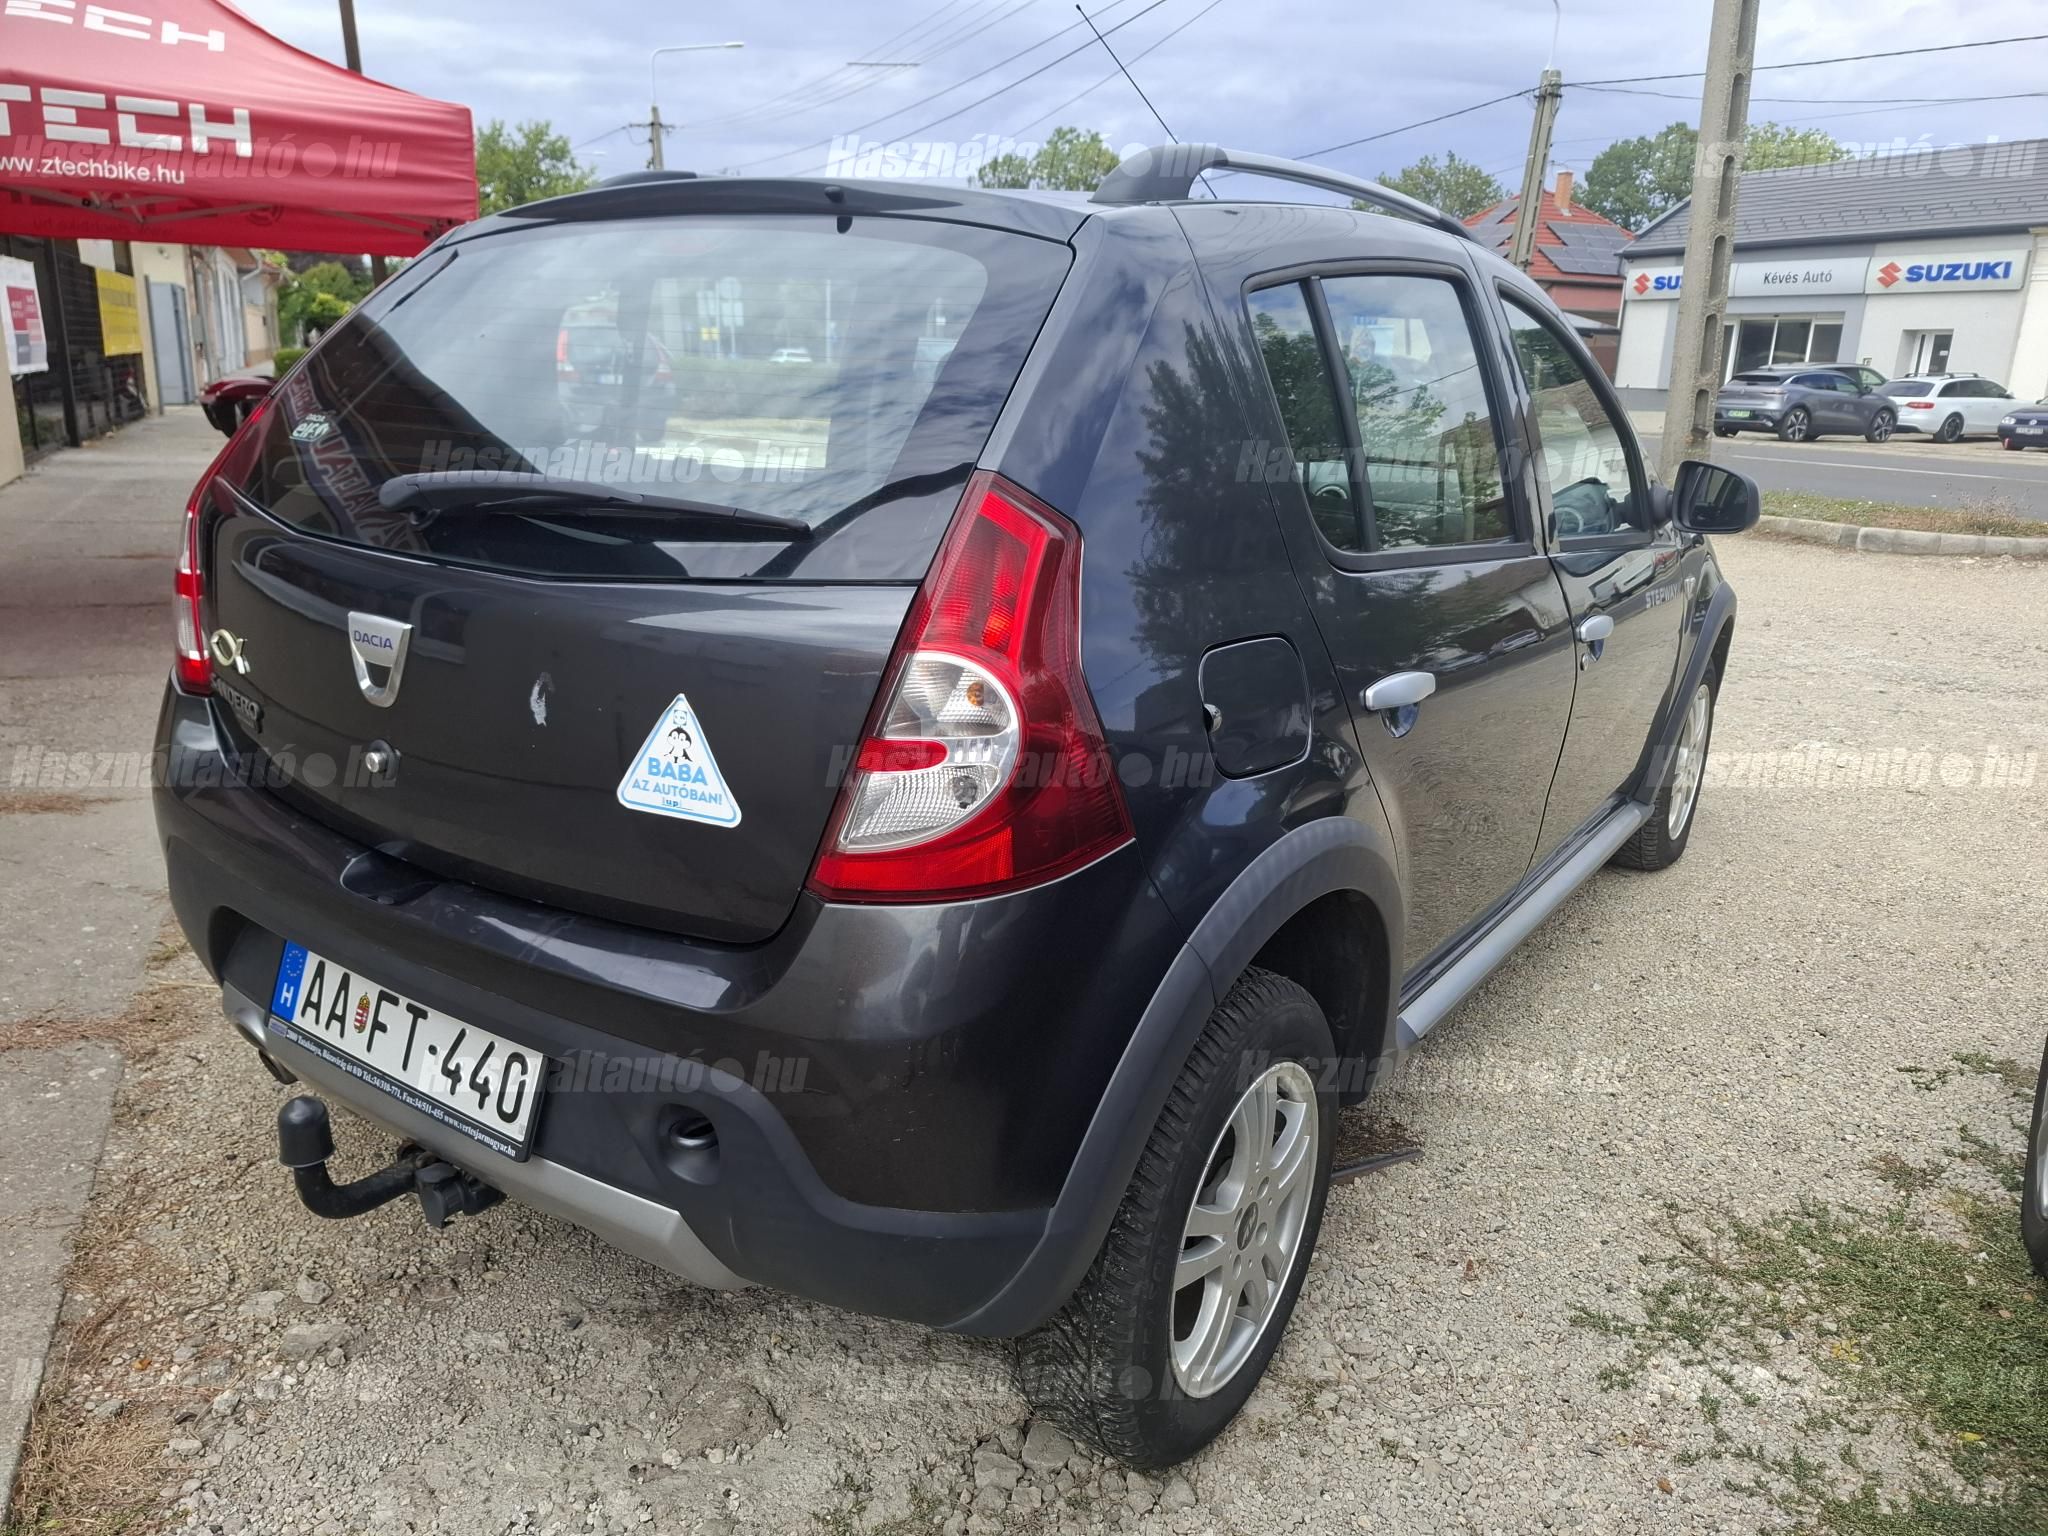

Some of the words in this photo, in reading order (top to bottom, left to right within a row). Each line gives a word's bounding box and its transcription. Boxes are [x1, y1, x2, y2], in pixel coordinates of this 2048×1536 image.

[1763, 271, 1798, 285] Kévés
[1802, 269, 1832, 284] Autó
[1905, 261, 2013, 282] SUZUKI
[353, 630, 393, 650] DACIA
[648, 757, 708, 786] BABA
[632, 779, 650, 792] AZ
[652, 783, 723, 805] AUTÓBAN!
[280, 982, 294, 1008] H
